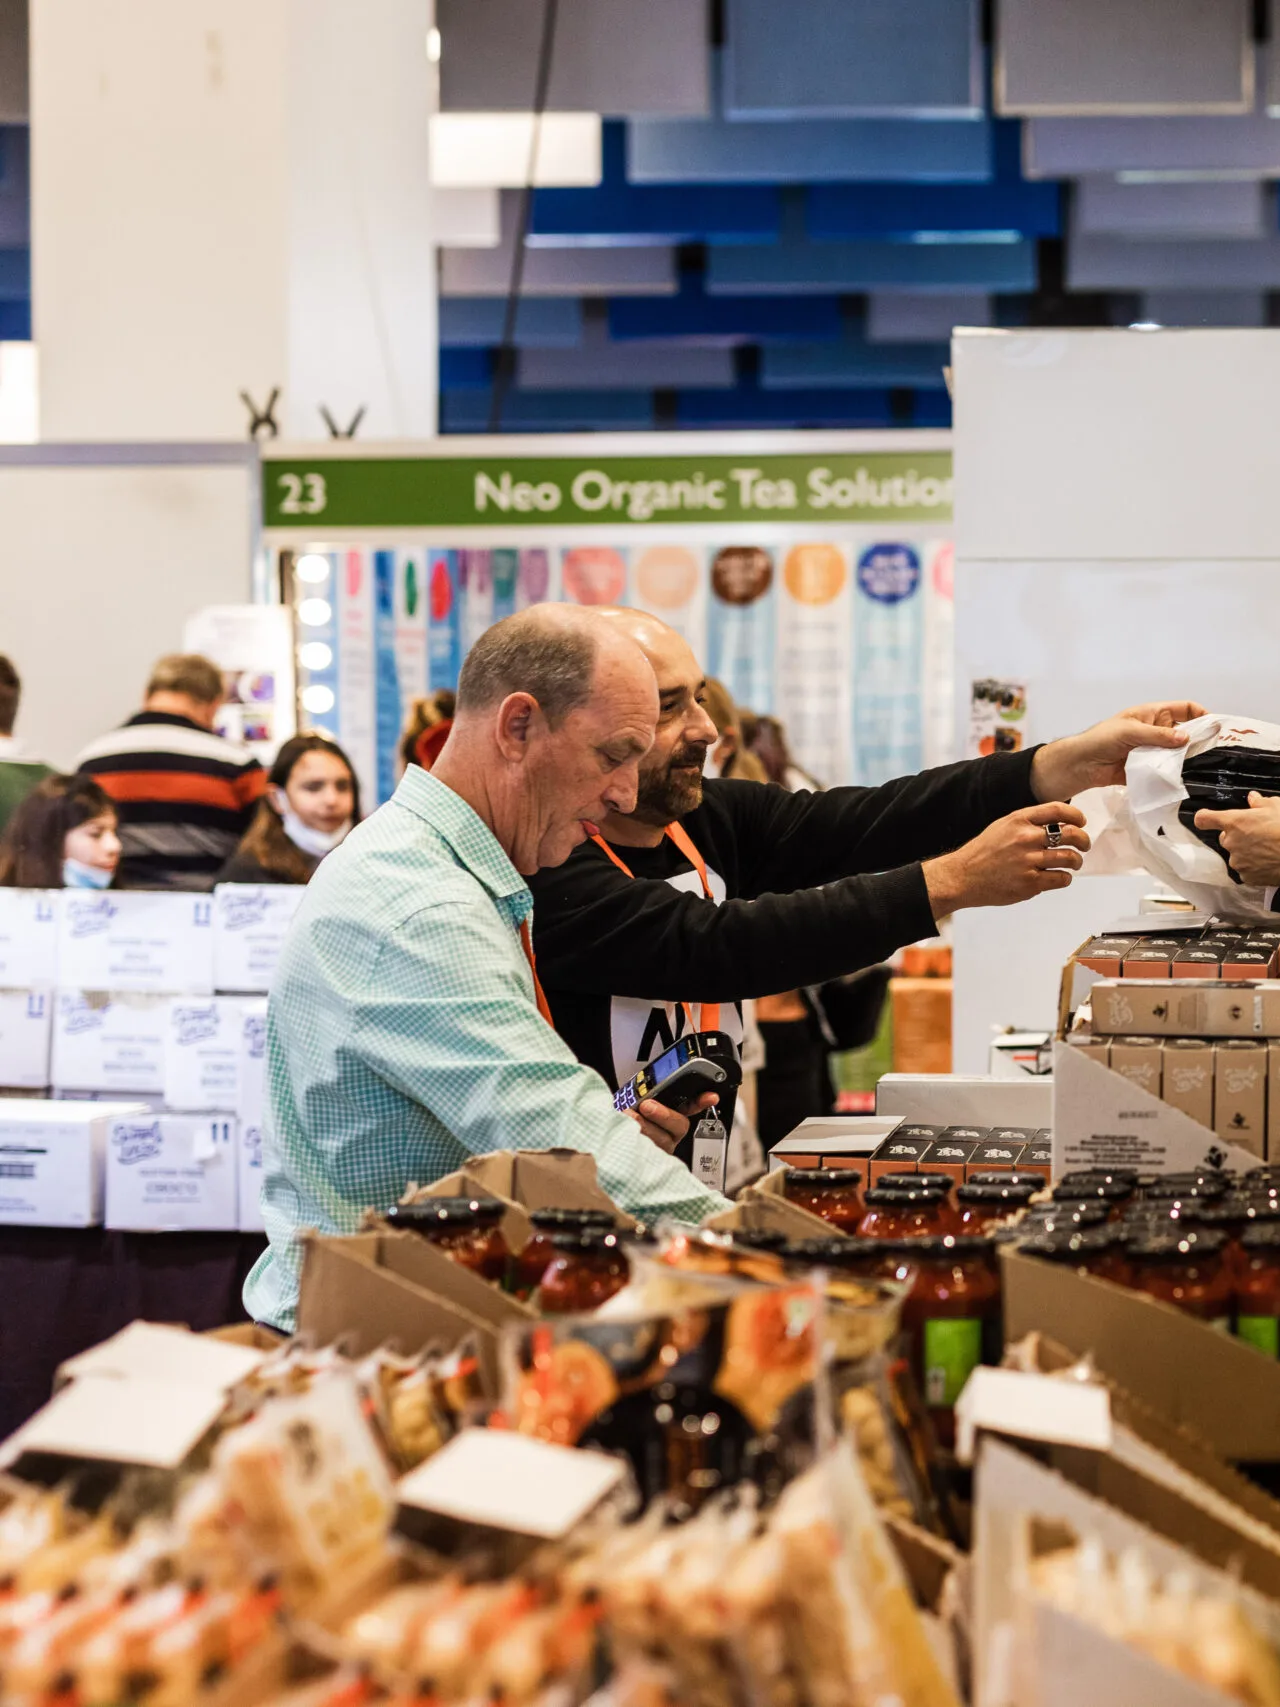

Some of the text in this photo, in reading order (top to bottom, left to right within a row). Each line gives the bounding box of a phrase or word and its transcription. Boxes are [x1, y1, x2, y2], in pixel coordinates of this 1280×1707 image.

[278, 473, 327, 514] 23
[474, 471, 562, 512] Neo
[571, 470, 726, 520] Organic
[730, 468, 798, 508] Tea
